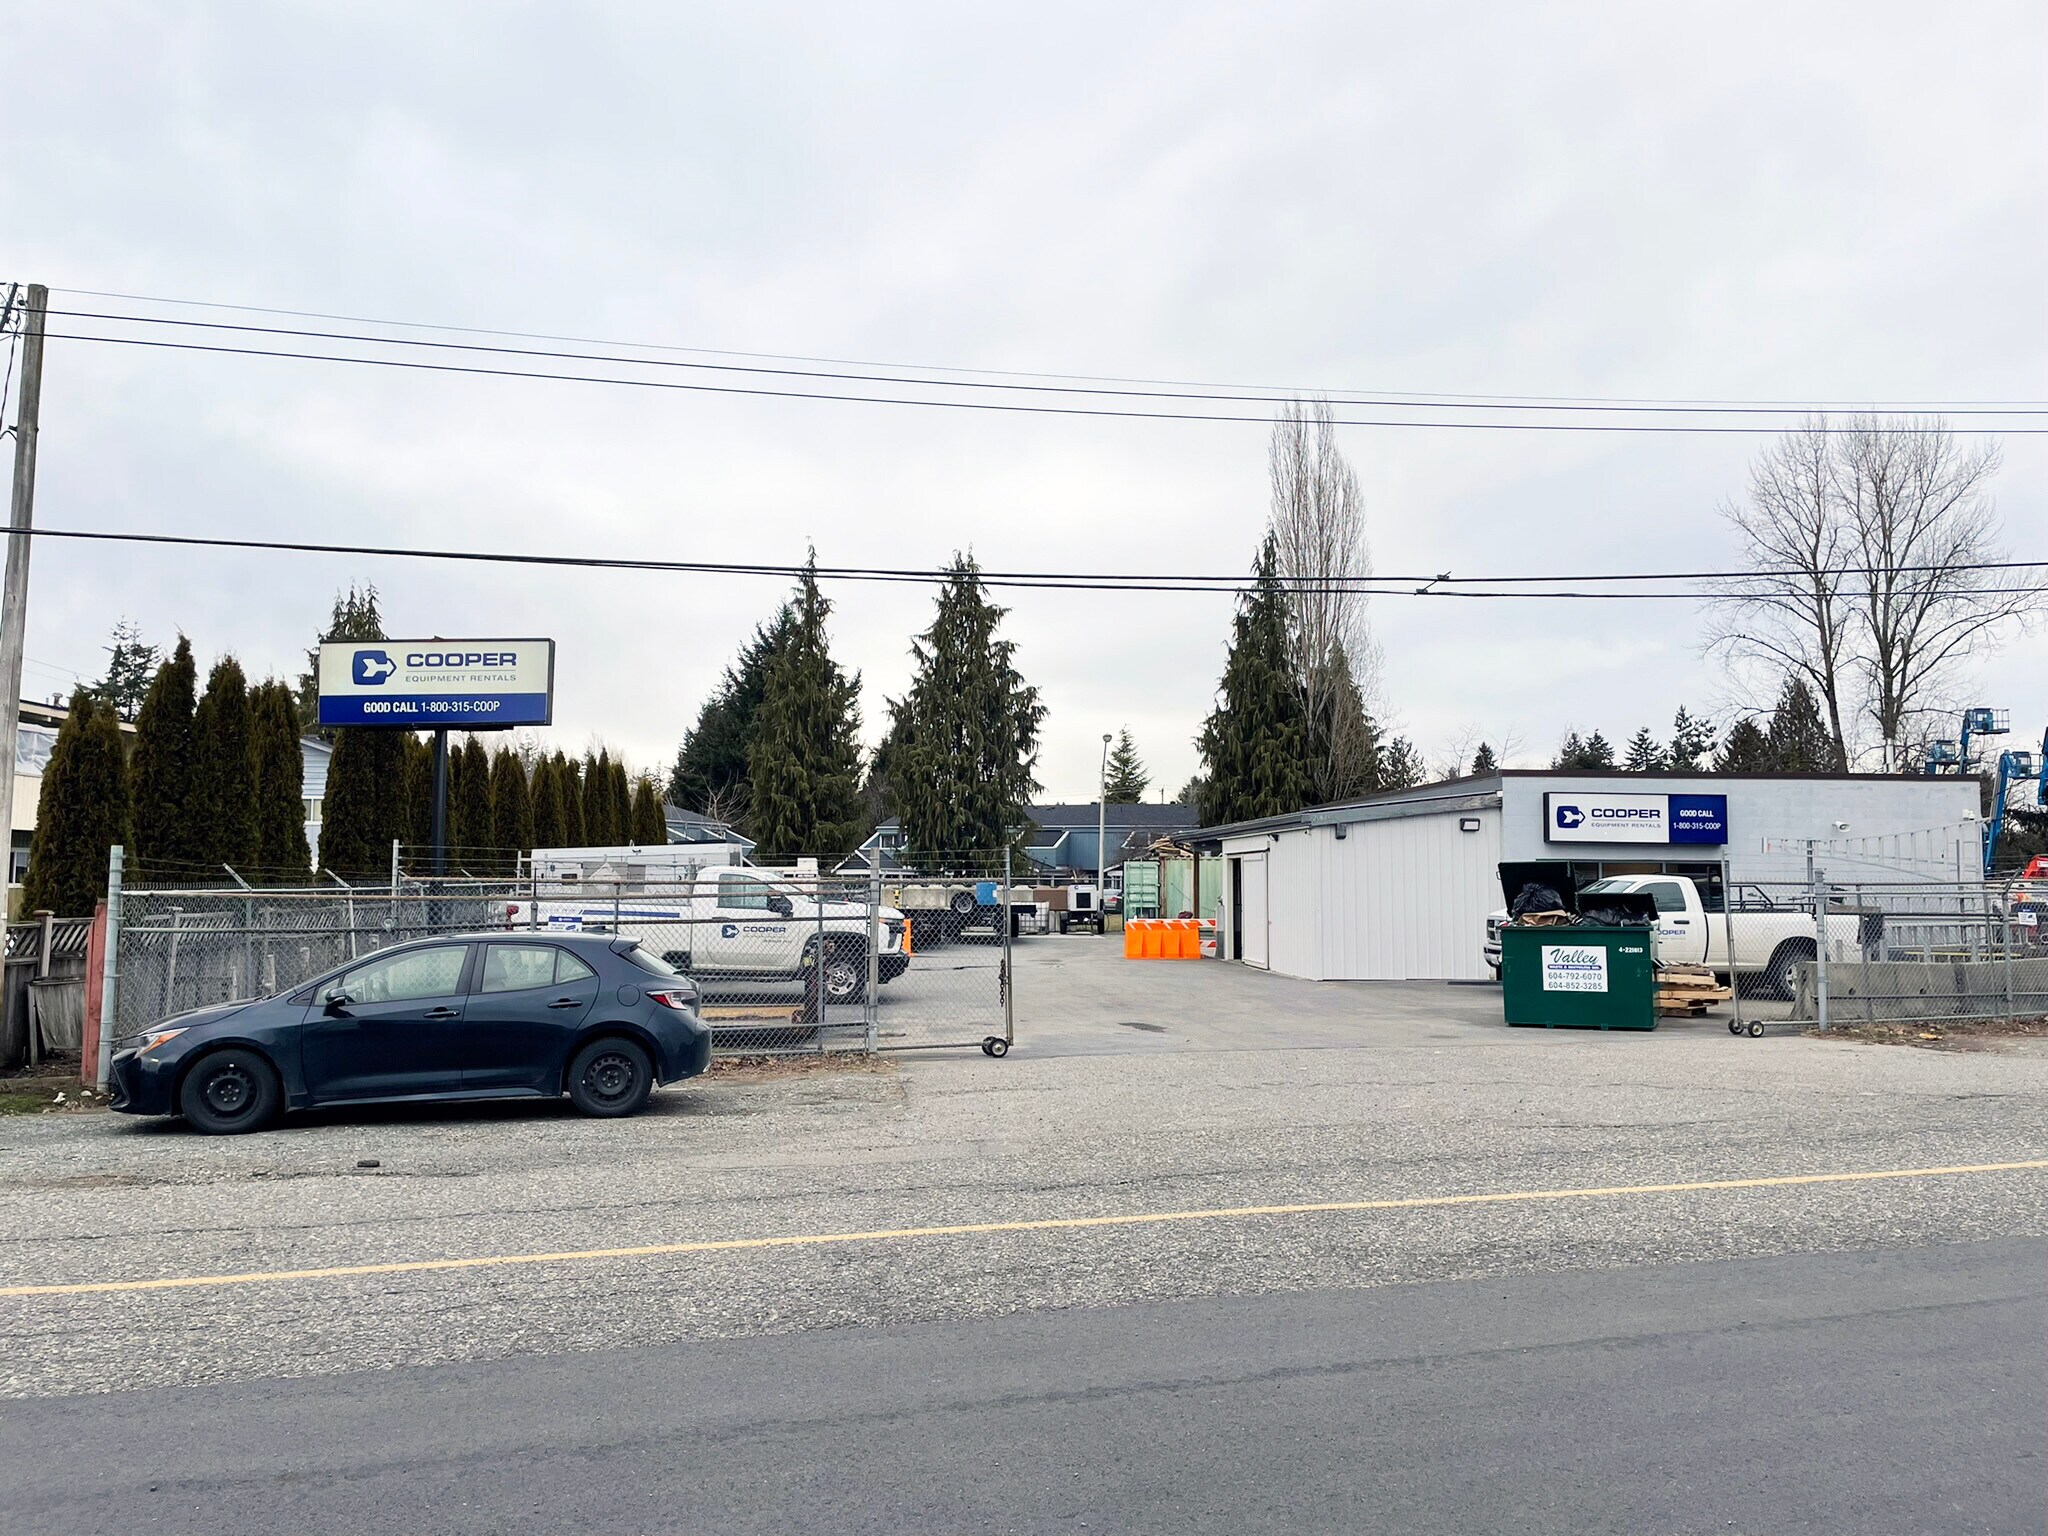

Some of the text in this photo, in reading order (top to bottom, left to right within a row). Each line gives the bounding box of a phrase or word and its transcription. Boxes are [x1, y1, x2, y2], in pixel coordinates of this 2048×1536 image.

[406, 653, 517, 667] COOPER
[405, 674, 517, 683] EQUIPMENT RENTALS
[363, 701, 500, 713] GOOD CALL 1-800-315-COOP
[1591, 808, 1661, 819] COOPER
[1679, 809, 1714, 818] GOOD CALL
[1673, 822, 1722, 830] 1-800-315-COOP
[1550, 948, 1598, 965] Valley
[1548, 972, 1602, 980] 604-792-6070
[1548, 981, 1603, 990] 604-852-3285
